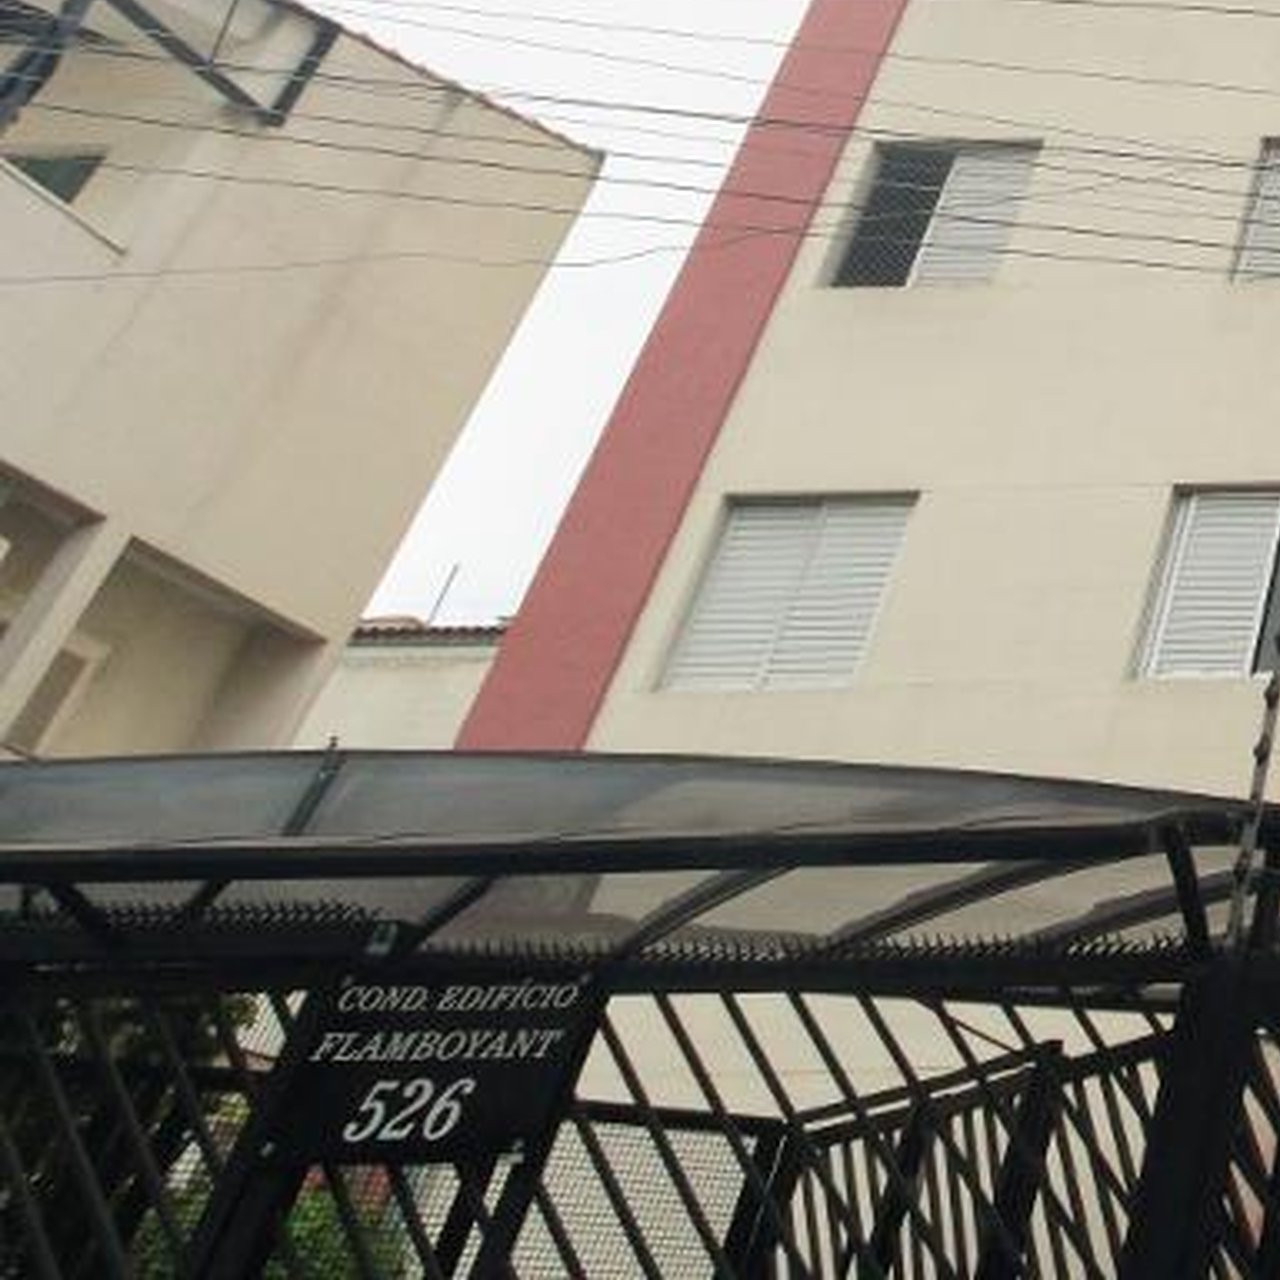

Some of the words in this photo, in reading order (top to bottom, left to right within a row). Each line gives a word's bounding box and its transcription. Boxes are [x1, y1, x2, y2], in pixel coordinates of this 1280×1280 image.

[436, 977, 579, 1012] EDIFÍCIO
[309, 1028, 565, 1062] FLAMBOYANT
[342, 1077, 477, 1143] 526
